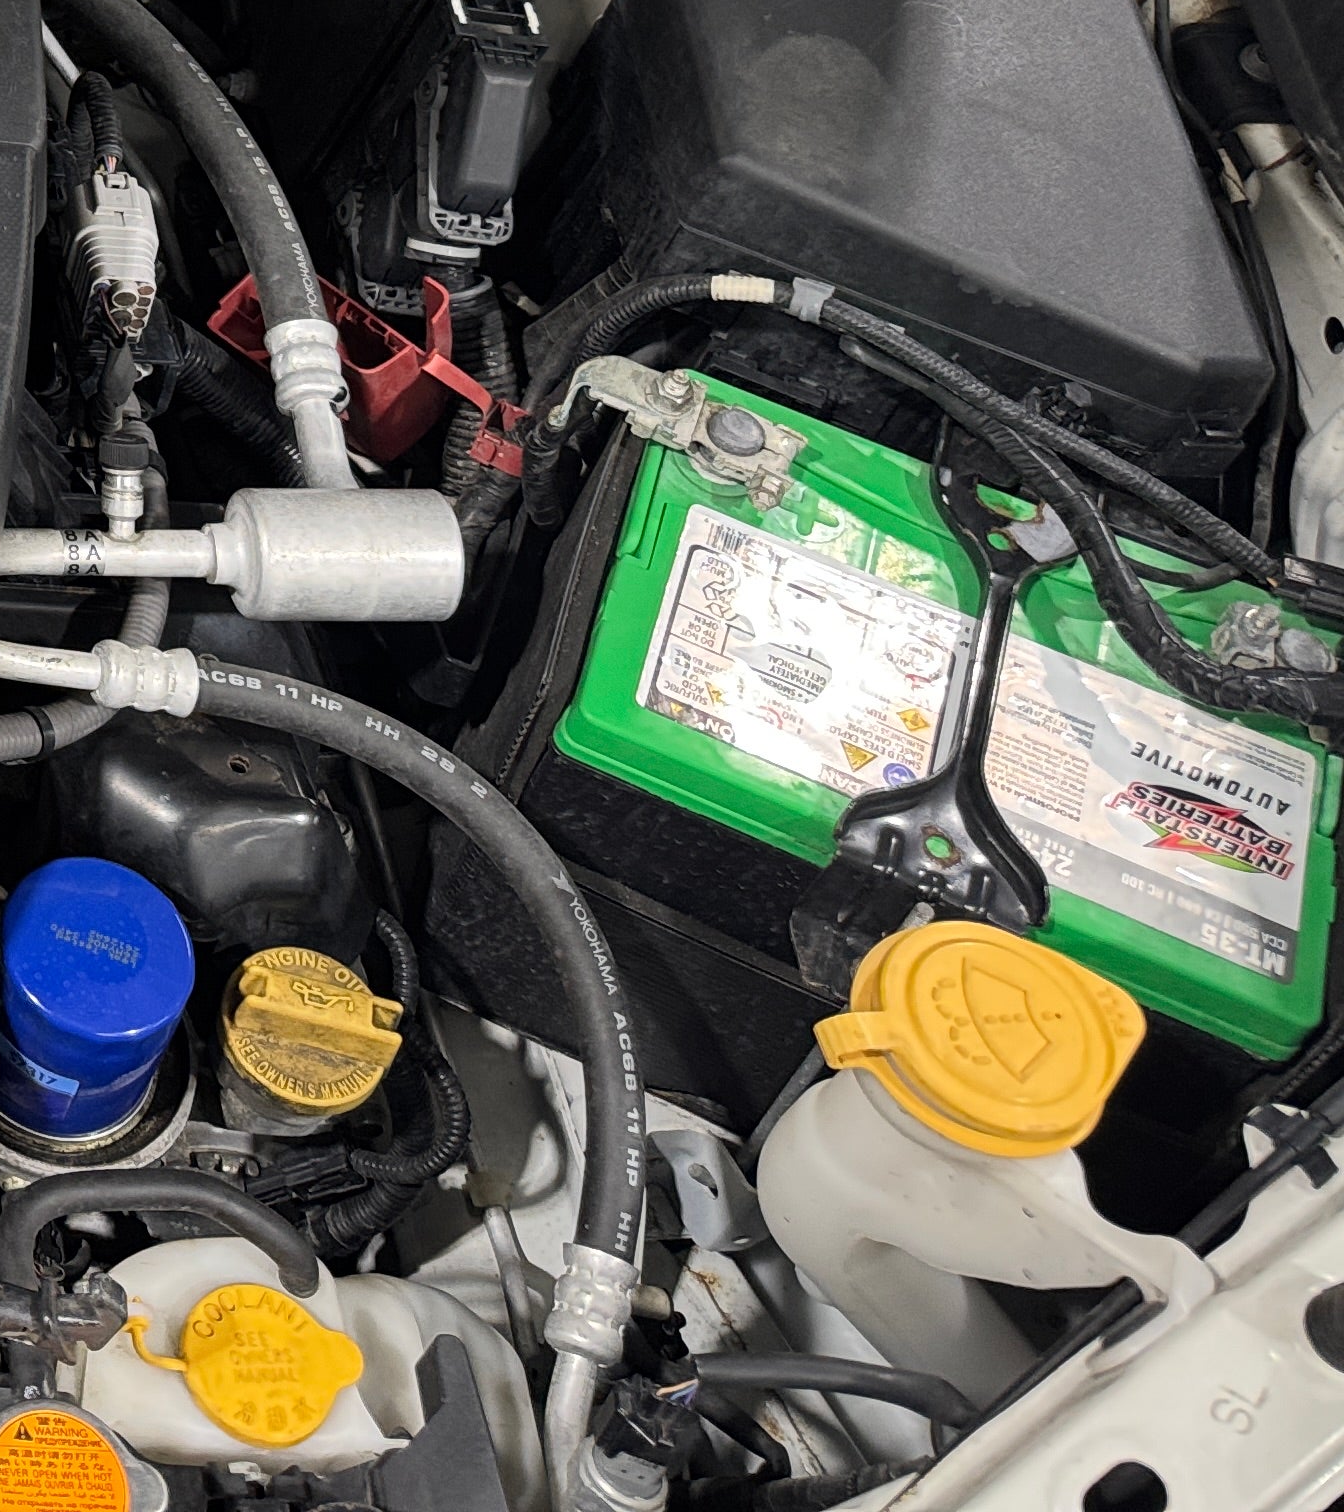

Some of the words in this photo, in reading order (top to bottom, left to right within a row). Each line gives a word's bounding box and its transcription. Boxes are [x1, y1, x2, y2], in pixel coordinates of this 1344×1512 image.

[292, 243, 319, 308] YOKOHAMA
[69, 544, 79, 561] 8
[86, 544, 101, 561] A
[273, 684, 299, 701] 11
[311, 694, 344, 713] HP
[365, 715, 401, 741] HH
[420, 745, 456, 775] 28
[1129, 740, 1290, 817] AUTOMOTIVE
[1114, 793, 1287, 877] INTERSTATE
[1130, 782, 1285, 855] BATTERIES
[569, 896, 618, 996] YOKOHAMA
[1197, 921, 1287, 976] MT-35
[1259, 930, 1286, 951] CCA
[236, 1037, 261, 1065] SEE
[319, 1069, 374, 1099] MANUAL
[612, 1010, 636, 1090] AC6B
[626, 1107, 639, 1134] 11
[626, 1147, 638, 1186] HP
[614, 1210, 631, 1252] HH
[192, 1289, 309, 1339] COOLANT
[234, 1330, 269, 1347] SEE
[33, 1427, 89, 1438] WARNING
[1209, 1385, 1271, 1436] SL
[32, 1469, 57, 1479] OPEN
[61, 1471, 90, 1481] WHEN
[93, 1472, 112, 1482] HOT
